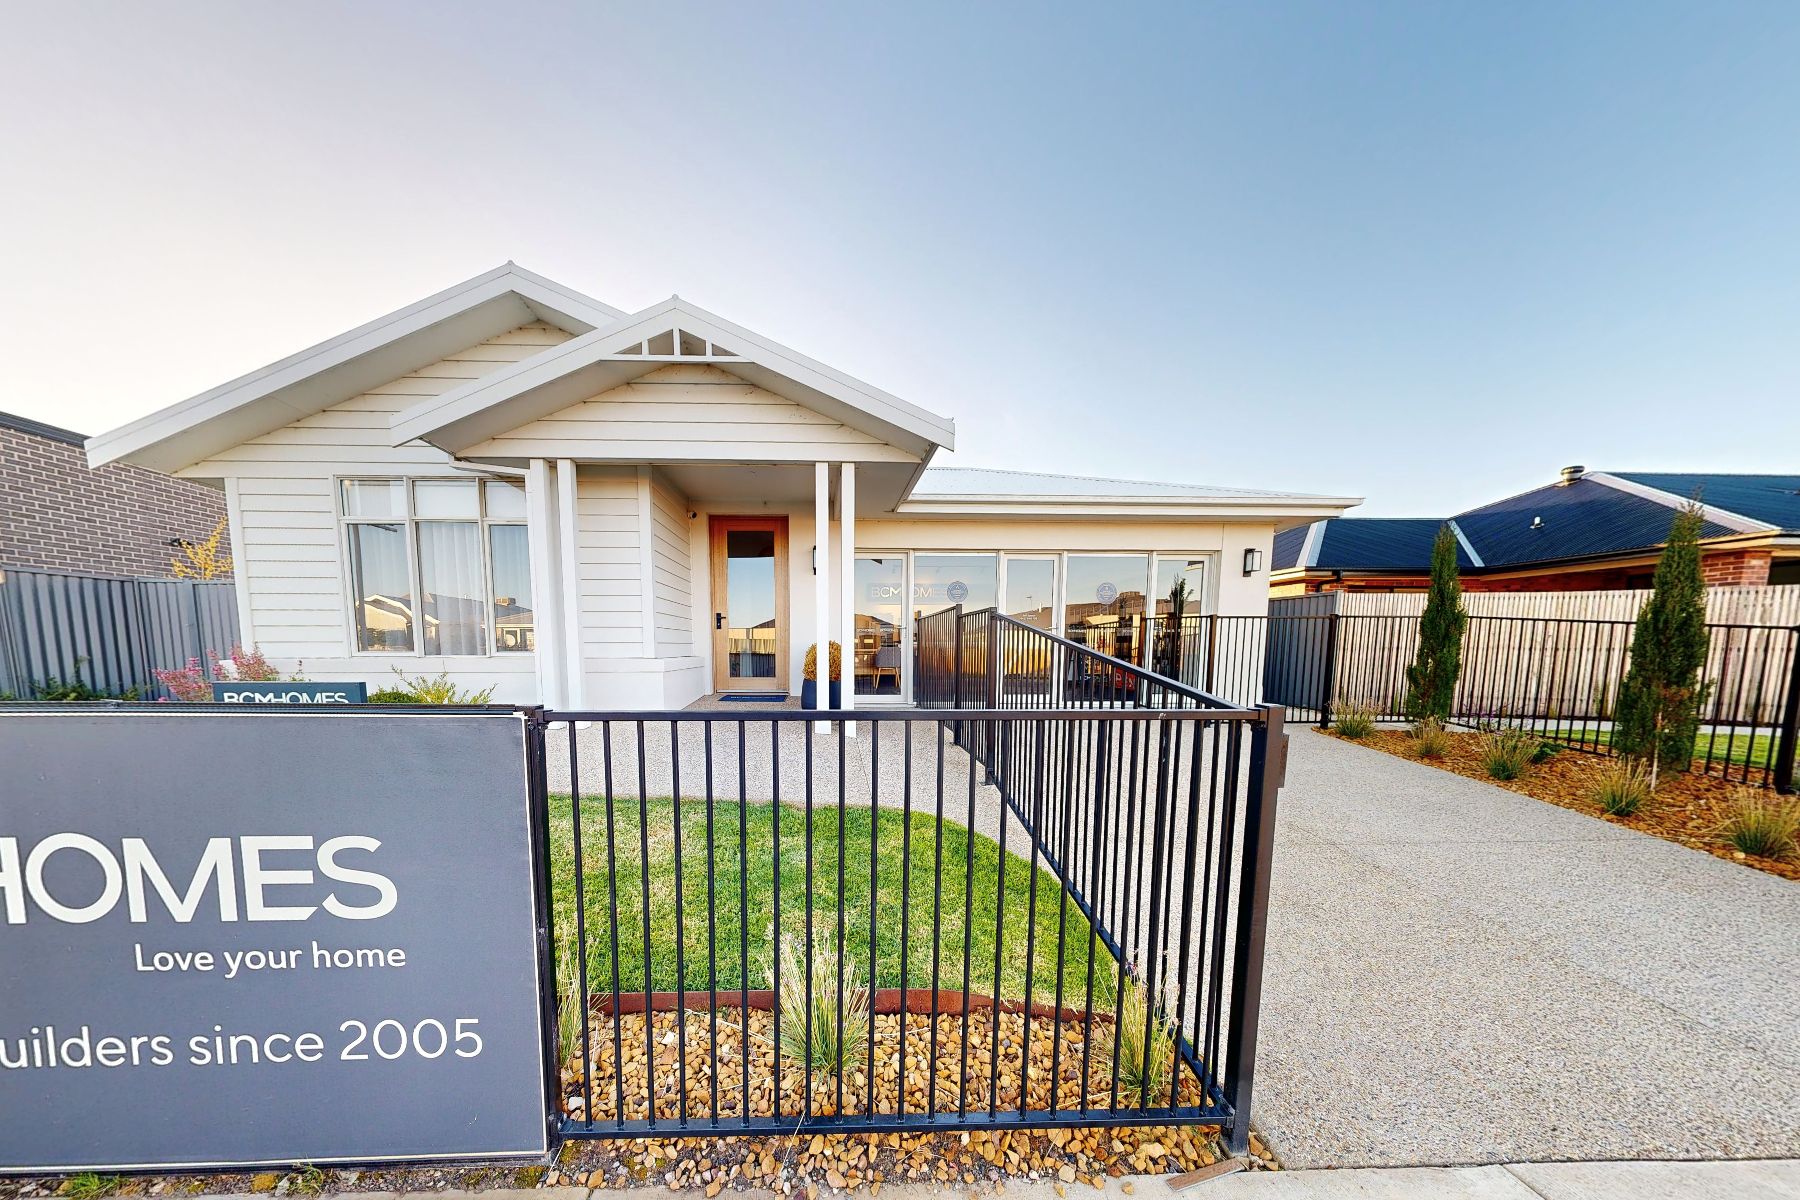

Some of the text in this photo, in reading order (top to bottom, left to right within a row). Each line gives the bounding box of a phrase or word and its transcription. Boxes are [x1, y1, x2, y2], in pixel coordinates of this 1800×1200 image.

[135, 941, 406, 979] Love your home
[189, 1024, 324, 1065] since
[339, 1018, 483, 1060] 2005
